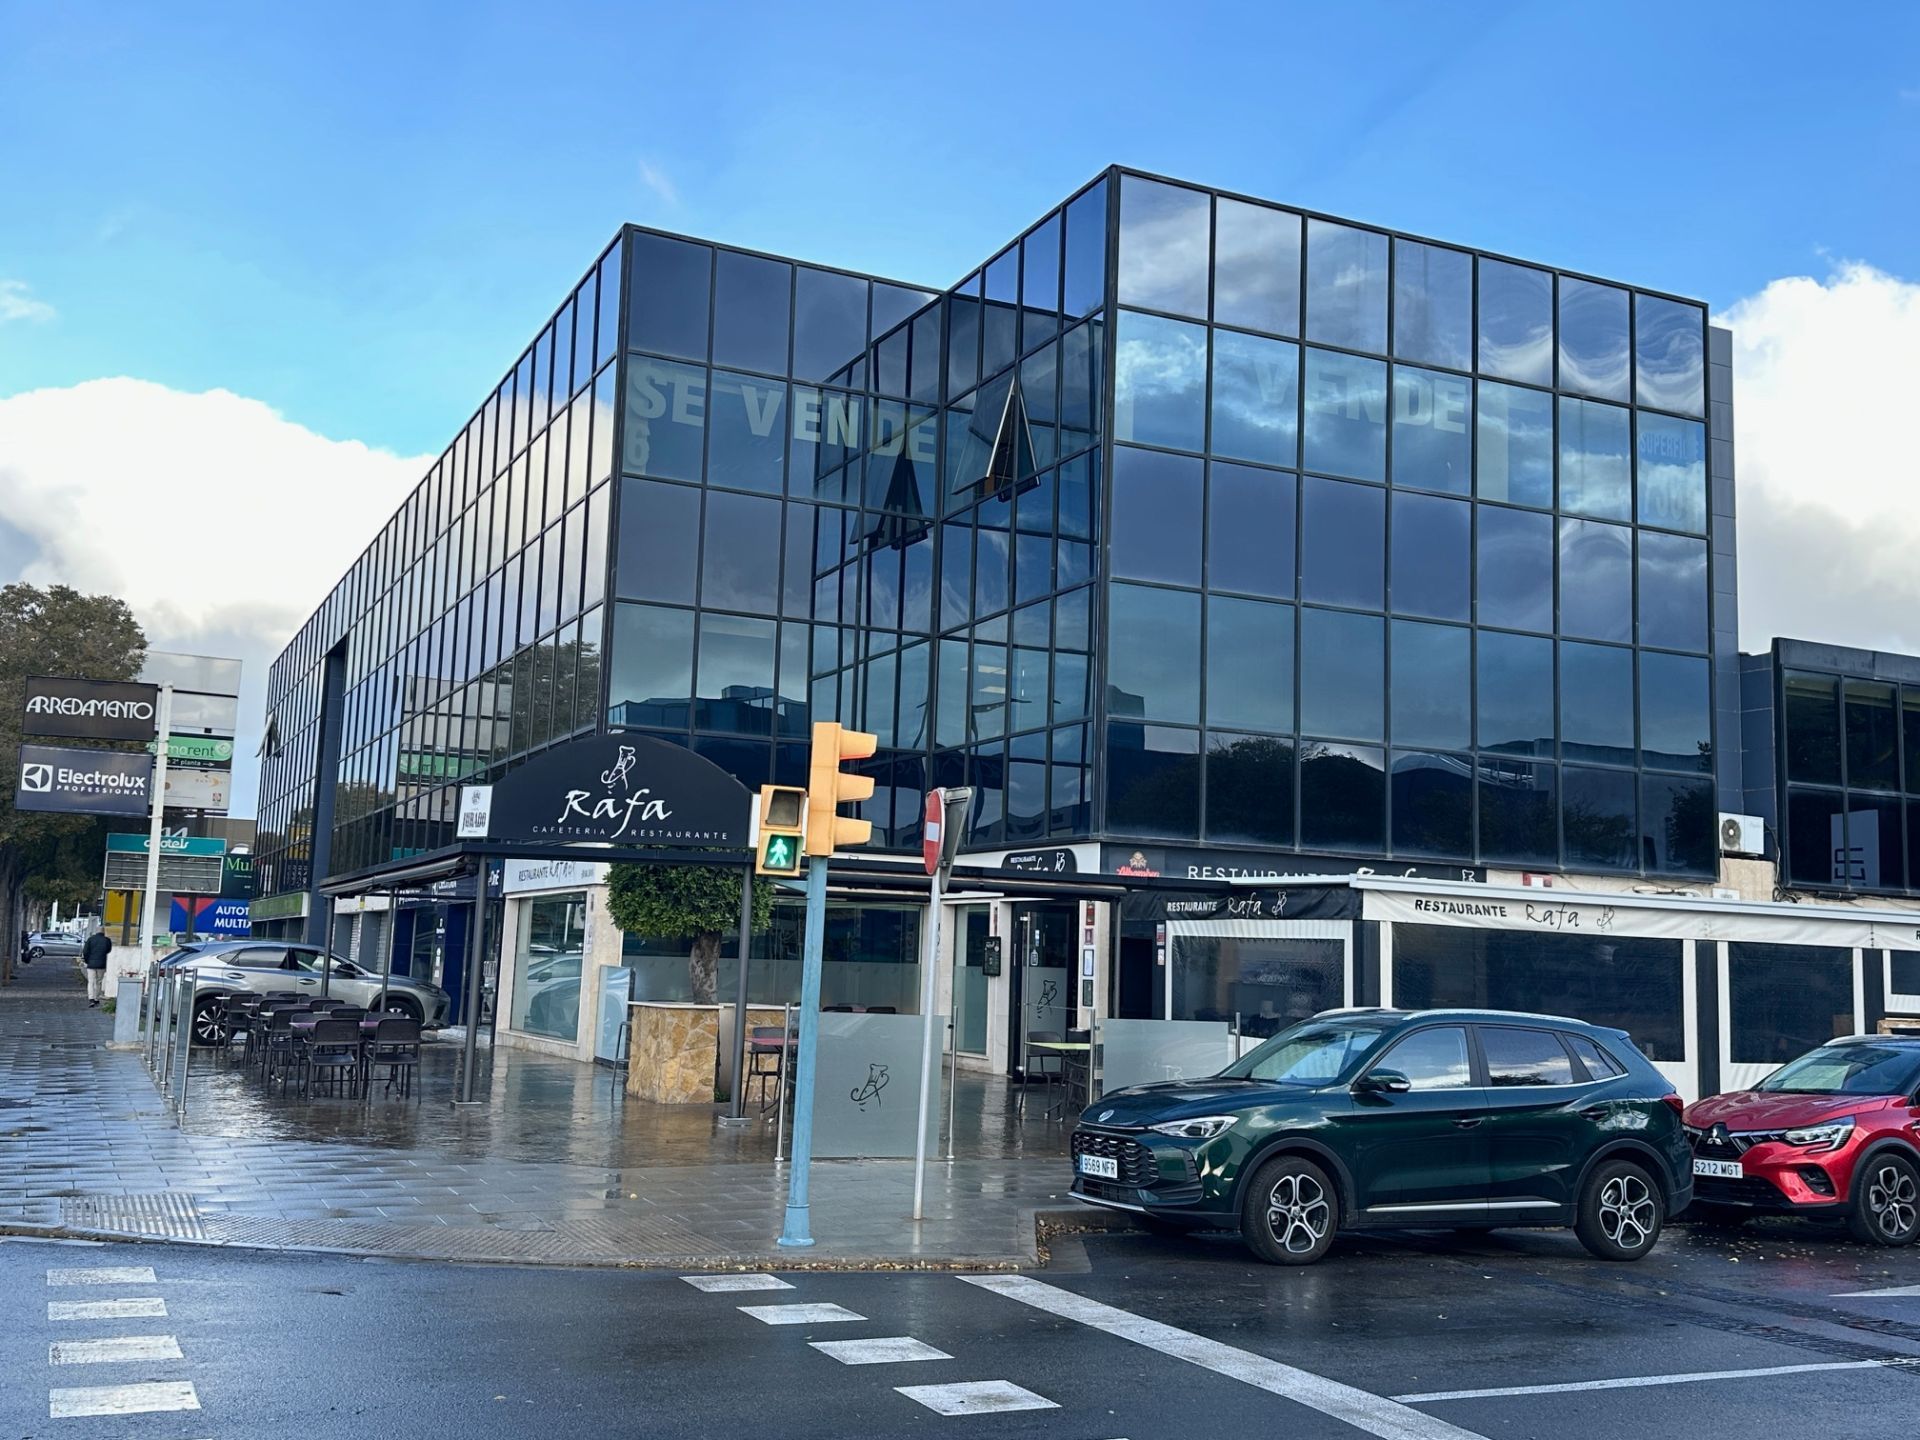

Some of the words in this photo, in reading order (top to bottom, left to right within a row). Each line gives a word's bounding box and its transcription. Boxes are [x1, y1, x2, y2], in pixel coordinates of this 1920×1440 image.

[1253, 358, 1467, 434] VENDE
[630, 366, 705, 428] SE
[739, 384, 937, 464] VENDE
[26, 695, 153, 720] ARREDAMENTO
[56, 785, 145, 796] PROFESSIONAL
[57, 768, 146, 788] Electrolux
[557, 788, 672, 839] Rafa
[532, 825, 606, 835] CAFETERIA
[631, 829, 728, 840] RESTAURANTE
[518, 866, 549, 882] RESTAURANTE
[1167, 901, 1217, 912] RESTAURANTE
[1227, 892, 1262, 918] Rafa
[1415, 899, 1507, 917] RESTAURANTE
[1525, 903, 1580, 930] Rafa
[1694, 1161, 1718, 1174] 5212
[1721, 1164, 1740, 1176] MGT
